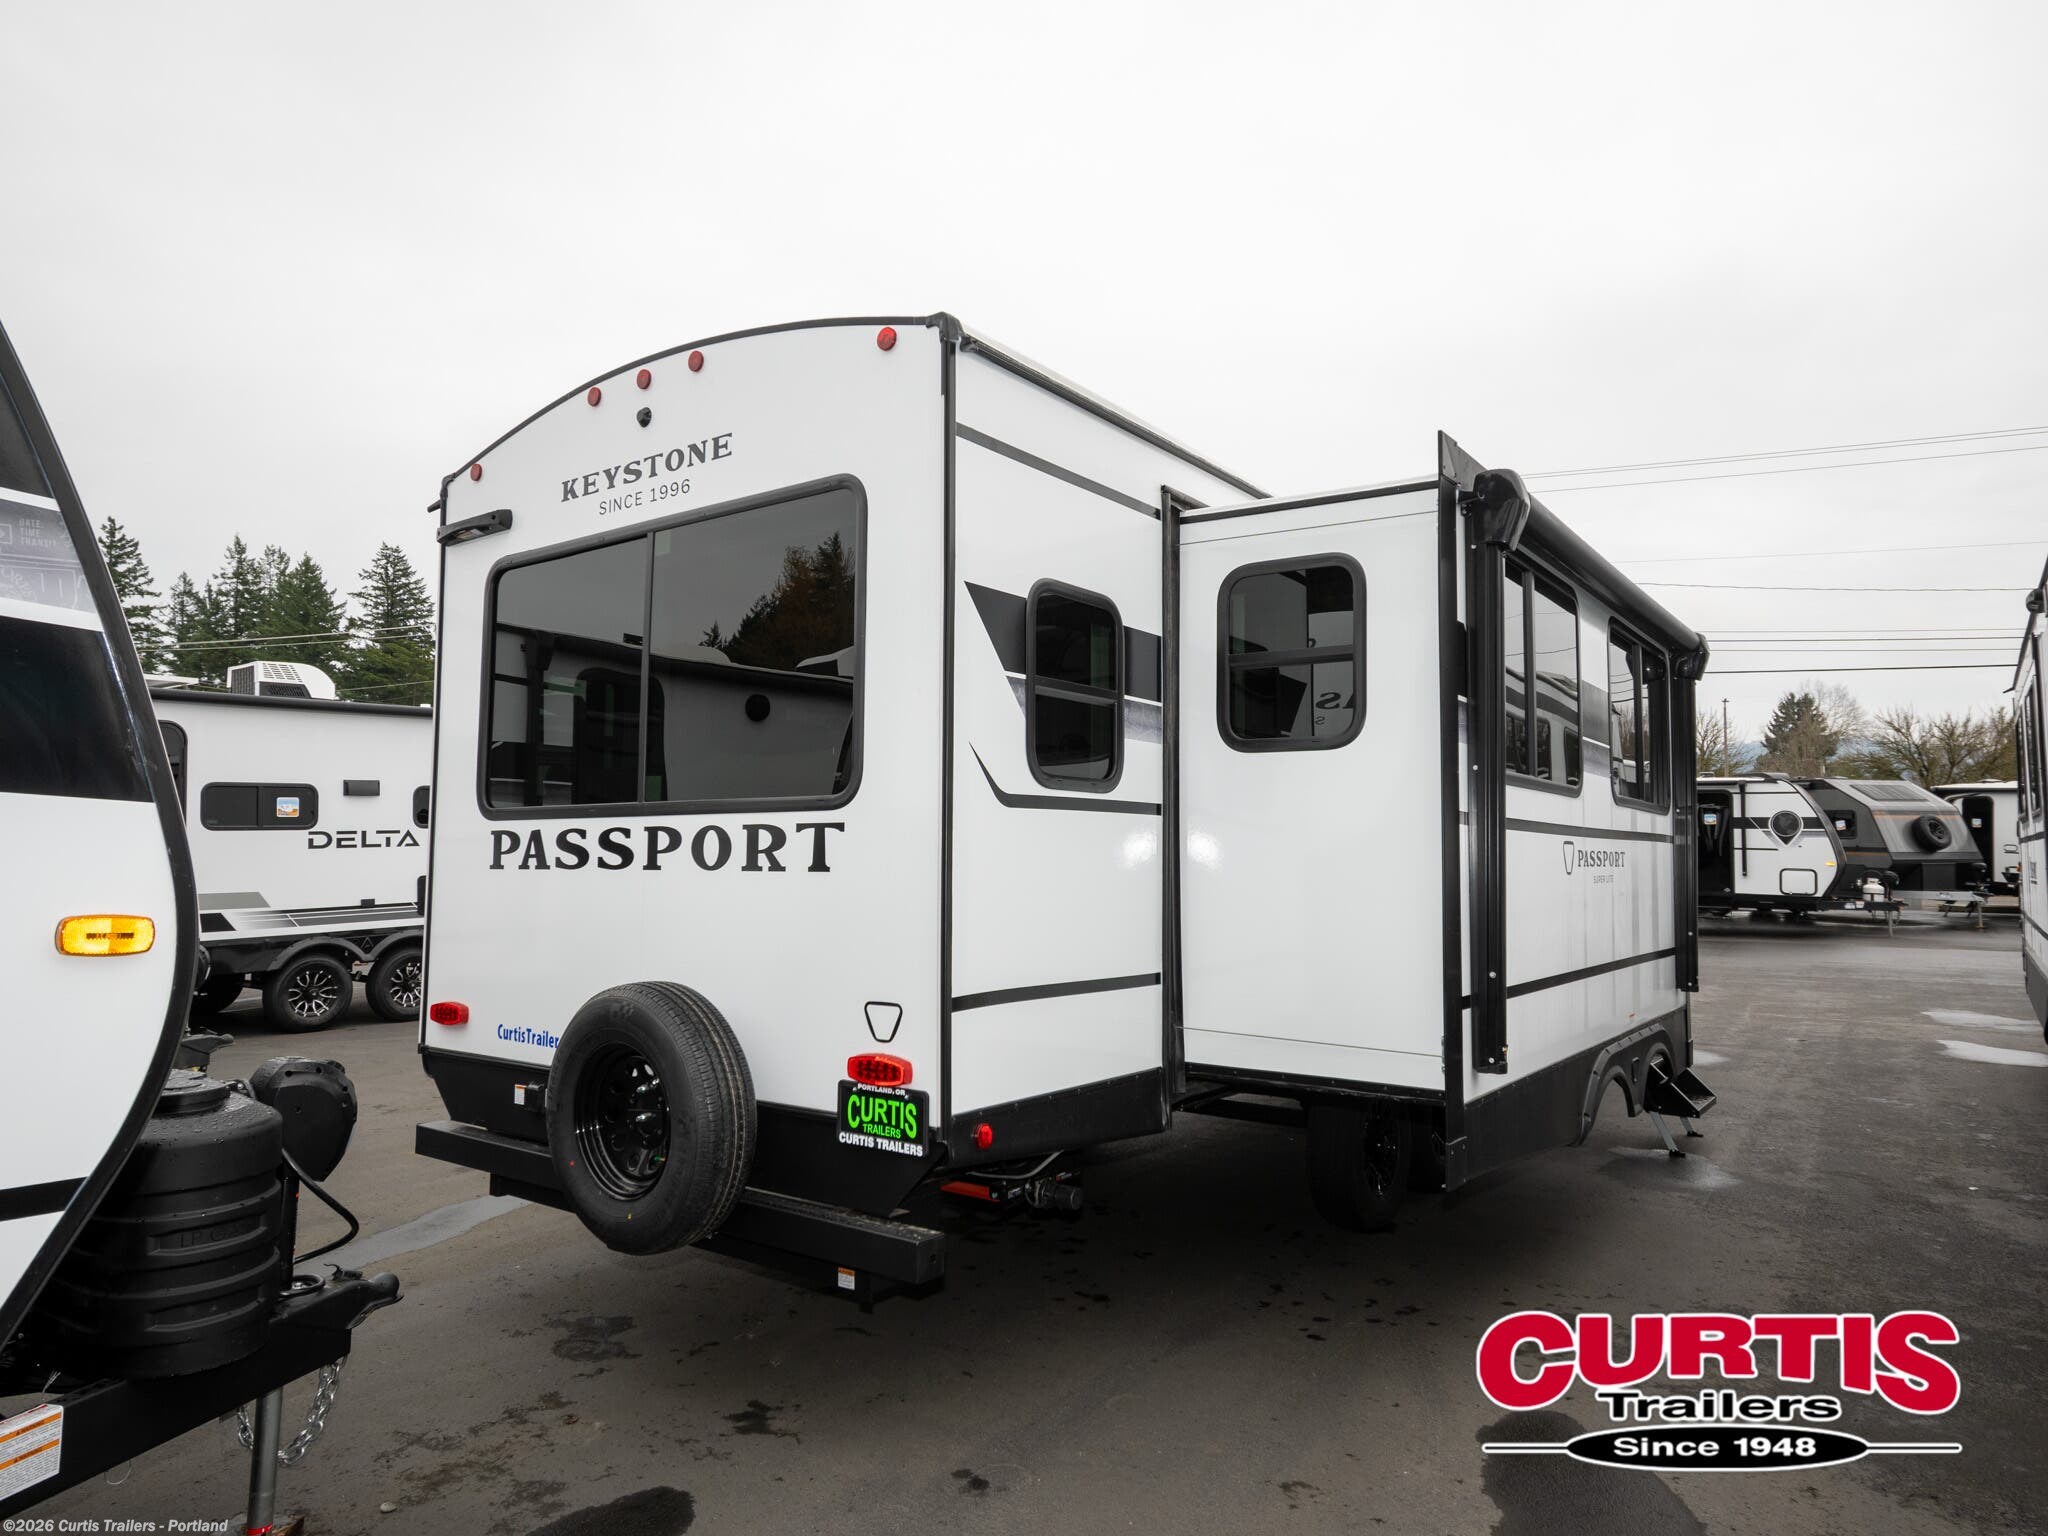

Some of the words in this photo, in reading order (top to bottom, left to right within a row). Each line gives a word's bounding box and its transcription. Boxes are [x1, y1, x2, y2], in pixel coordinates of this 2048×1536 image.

[561, 432, 733, 502] KEYSTONE
[599, 491, 643, 515] SINCE
[649, 478, 690, 502] 1996
[308, 829, 420, 849] DELTA
[489, 822, 845, 873] PASSPORT
[1577, 849, 1626, 867] PASSPORT
[847, 1094, 917, 1139] CURTIS
[862, 1123, 901, 1139] TRAILERS
[839, 1132, 875, 1148] CURTIS
[876, 1137, 923, 1157] TRAILERS
